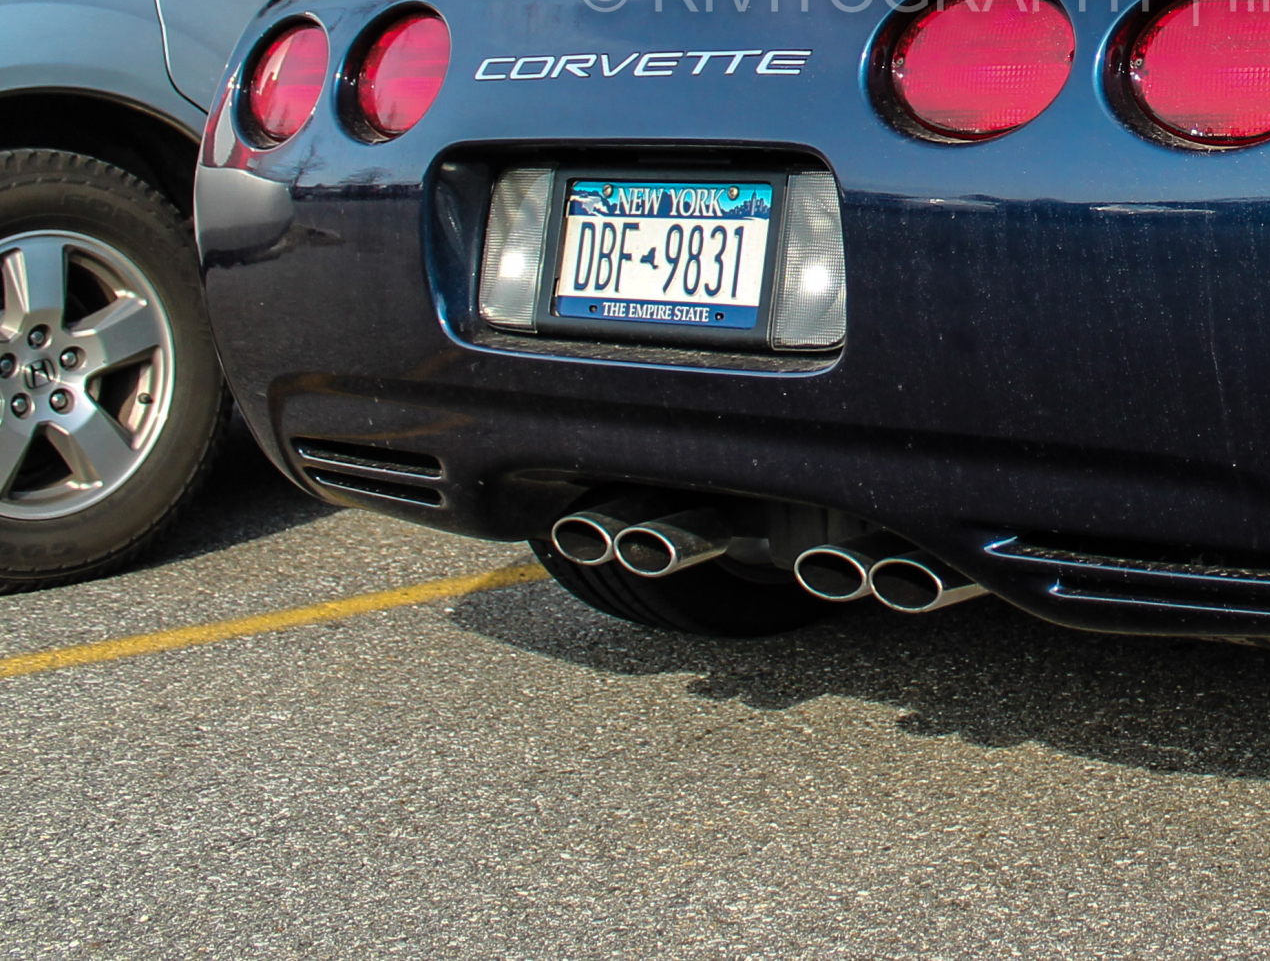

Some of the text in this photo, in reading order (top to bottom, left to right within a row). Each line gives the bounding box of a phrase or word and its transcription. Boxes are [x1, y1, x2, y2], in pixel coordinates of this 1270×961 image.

[474, 48, 812, 81] CORVETTE
[615, 187, 725, 217] NEW YORK
[573, 221, 744, 298] DBF 9831
[603, 302, 710, 322] THE EMPIRE STATE
